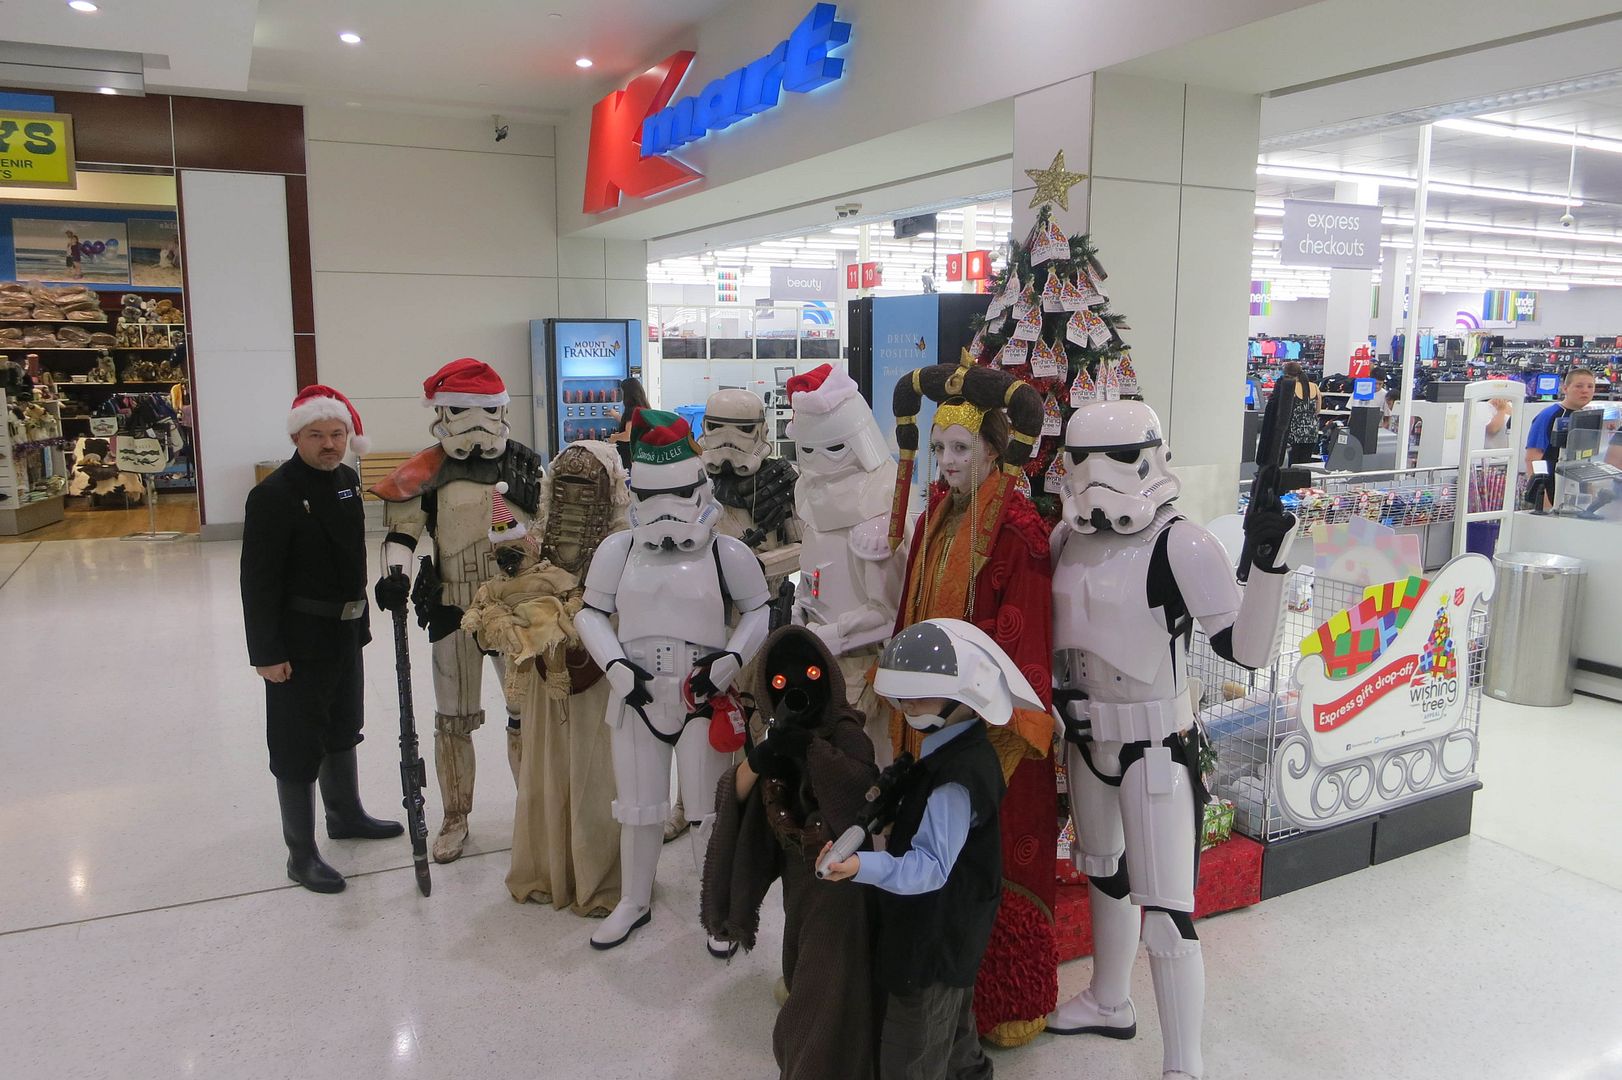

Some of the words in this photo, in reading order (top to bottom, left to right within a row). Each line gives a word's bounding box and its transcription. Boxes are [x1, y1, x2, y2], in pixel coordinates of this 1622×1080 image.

[1307, 213, 1360, 234] express
[1299, 233, 1364, 256] checkouts
[951, 261, 957, 274] 9
[850, 271, 857, 283] 11
[865, 269, 873, 281] 10
[786, 276, 822, 291] beauty
[1515, 294, 1535, 306] under
[564, 347, 616, 358] FRANKLIN
[880, 348, 927, 358] POSITIVE
[1319, 699, 1355, 726] Express
[1355, 684, 1374, 707] gift
[1375, 661, 1414, 690] drop-off
[1410, 677, 1457, 703] wishing
[1422, 698, 1444, 712] tree
[1424, 711, 1440, 719] APPEAL
